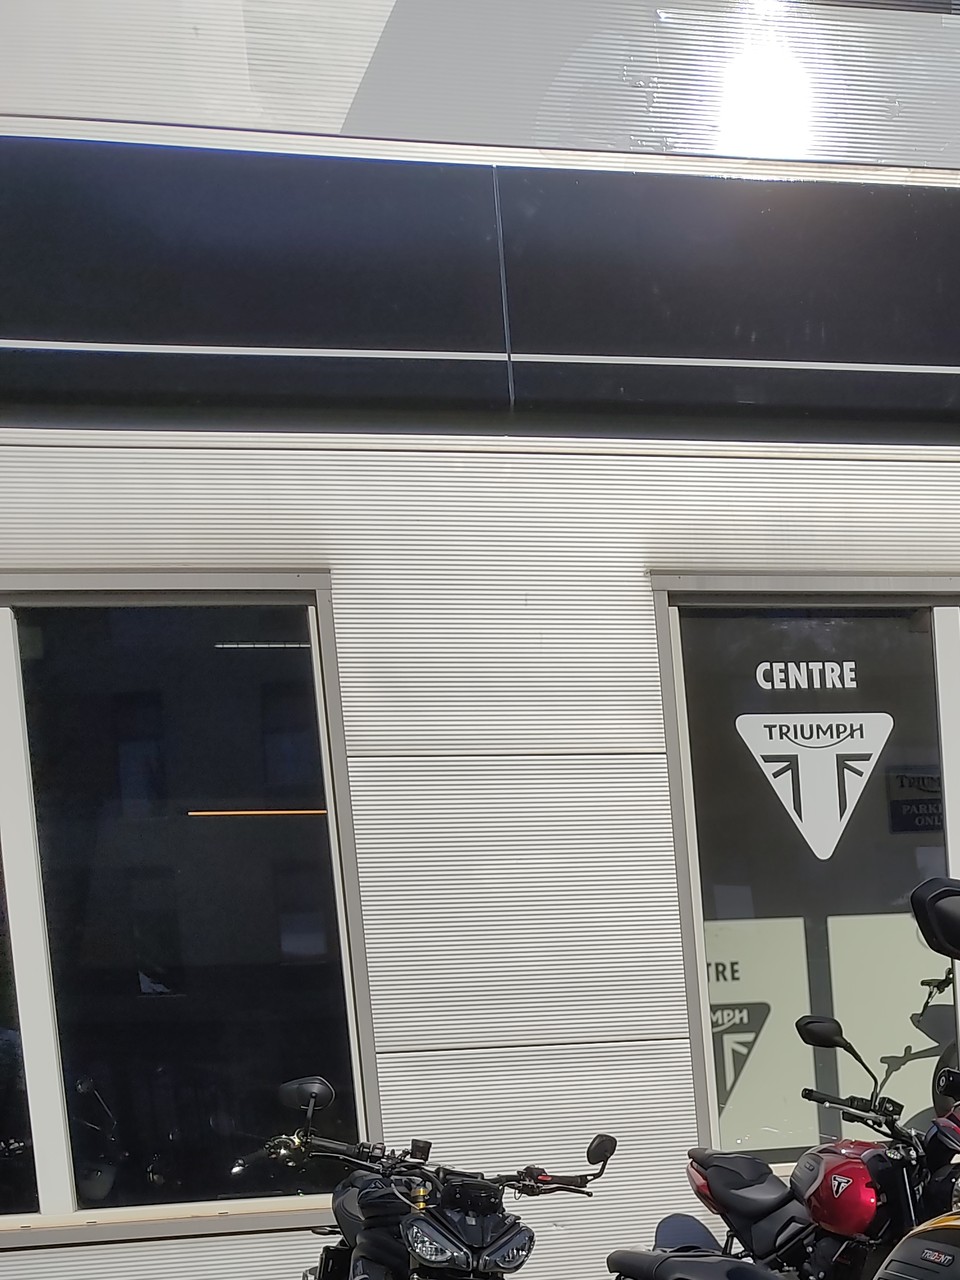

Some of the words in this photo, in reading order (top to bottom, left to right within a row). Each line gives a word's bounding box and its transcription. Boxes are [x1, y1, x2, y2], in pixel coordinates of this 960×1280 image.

[755, 660, 858, 690] CENTRE
[763, 723, 865, 746] TRIUMPH
[915, 815, 944, 826] ONL
